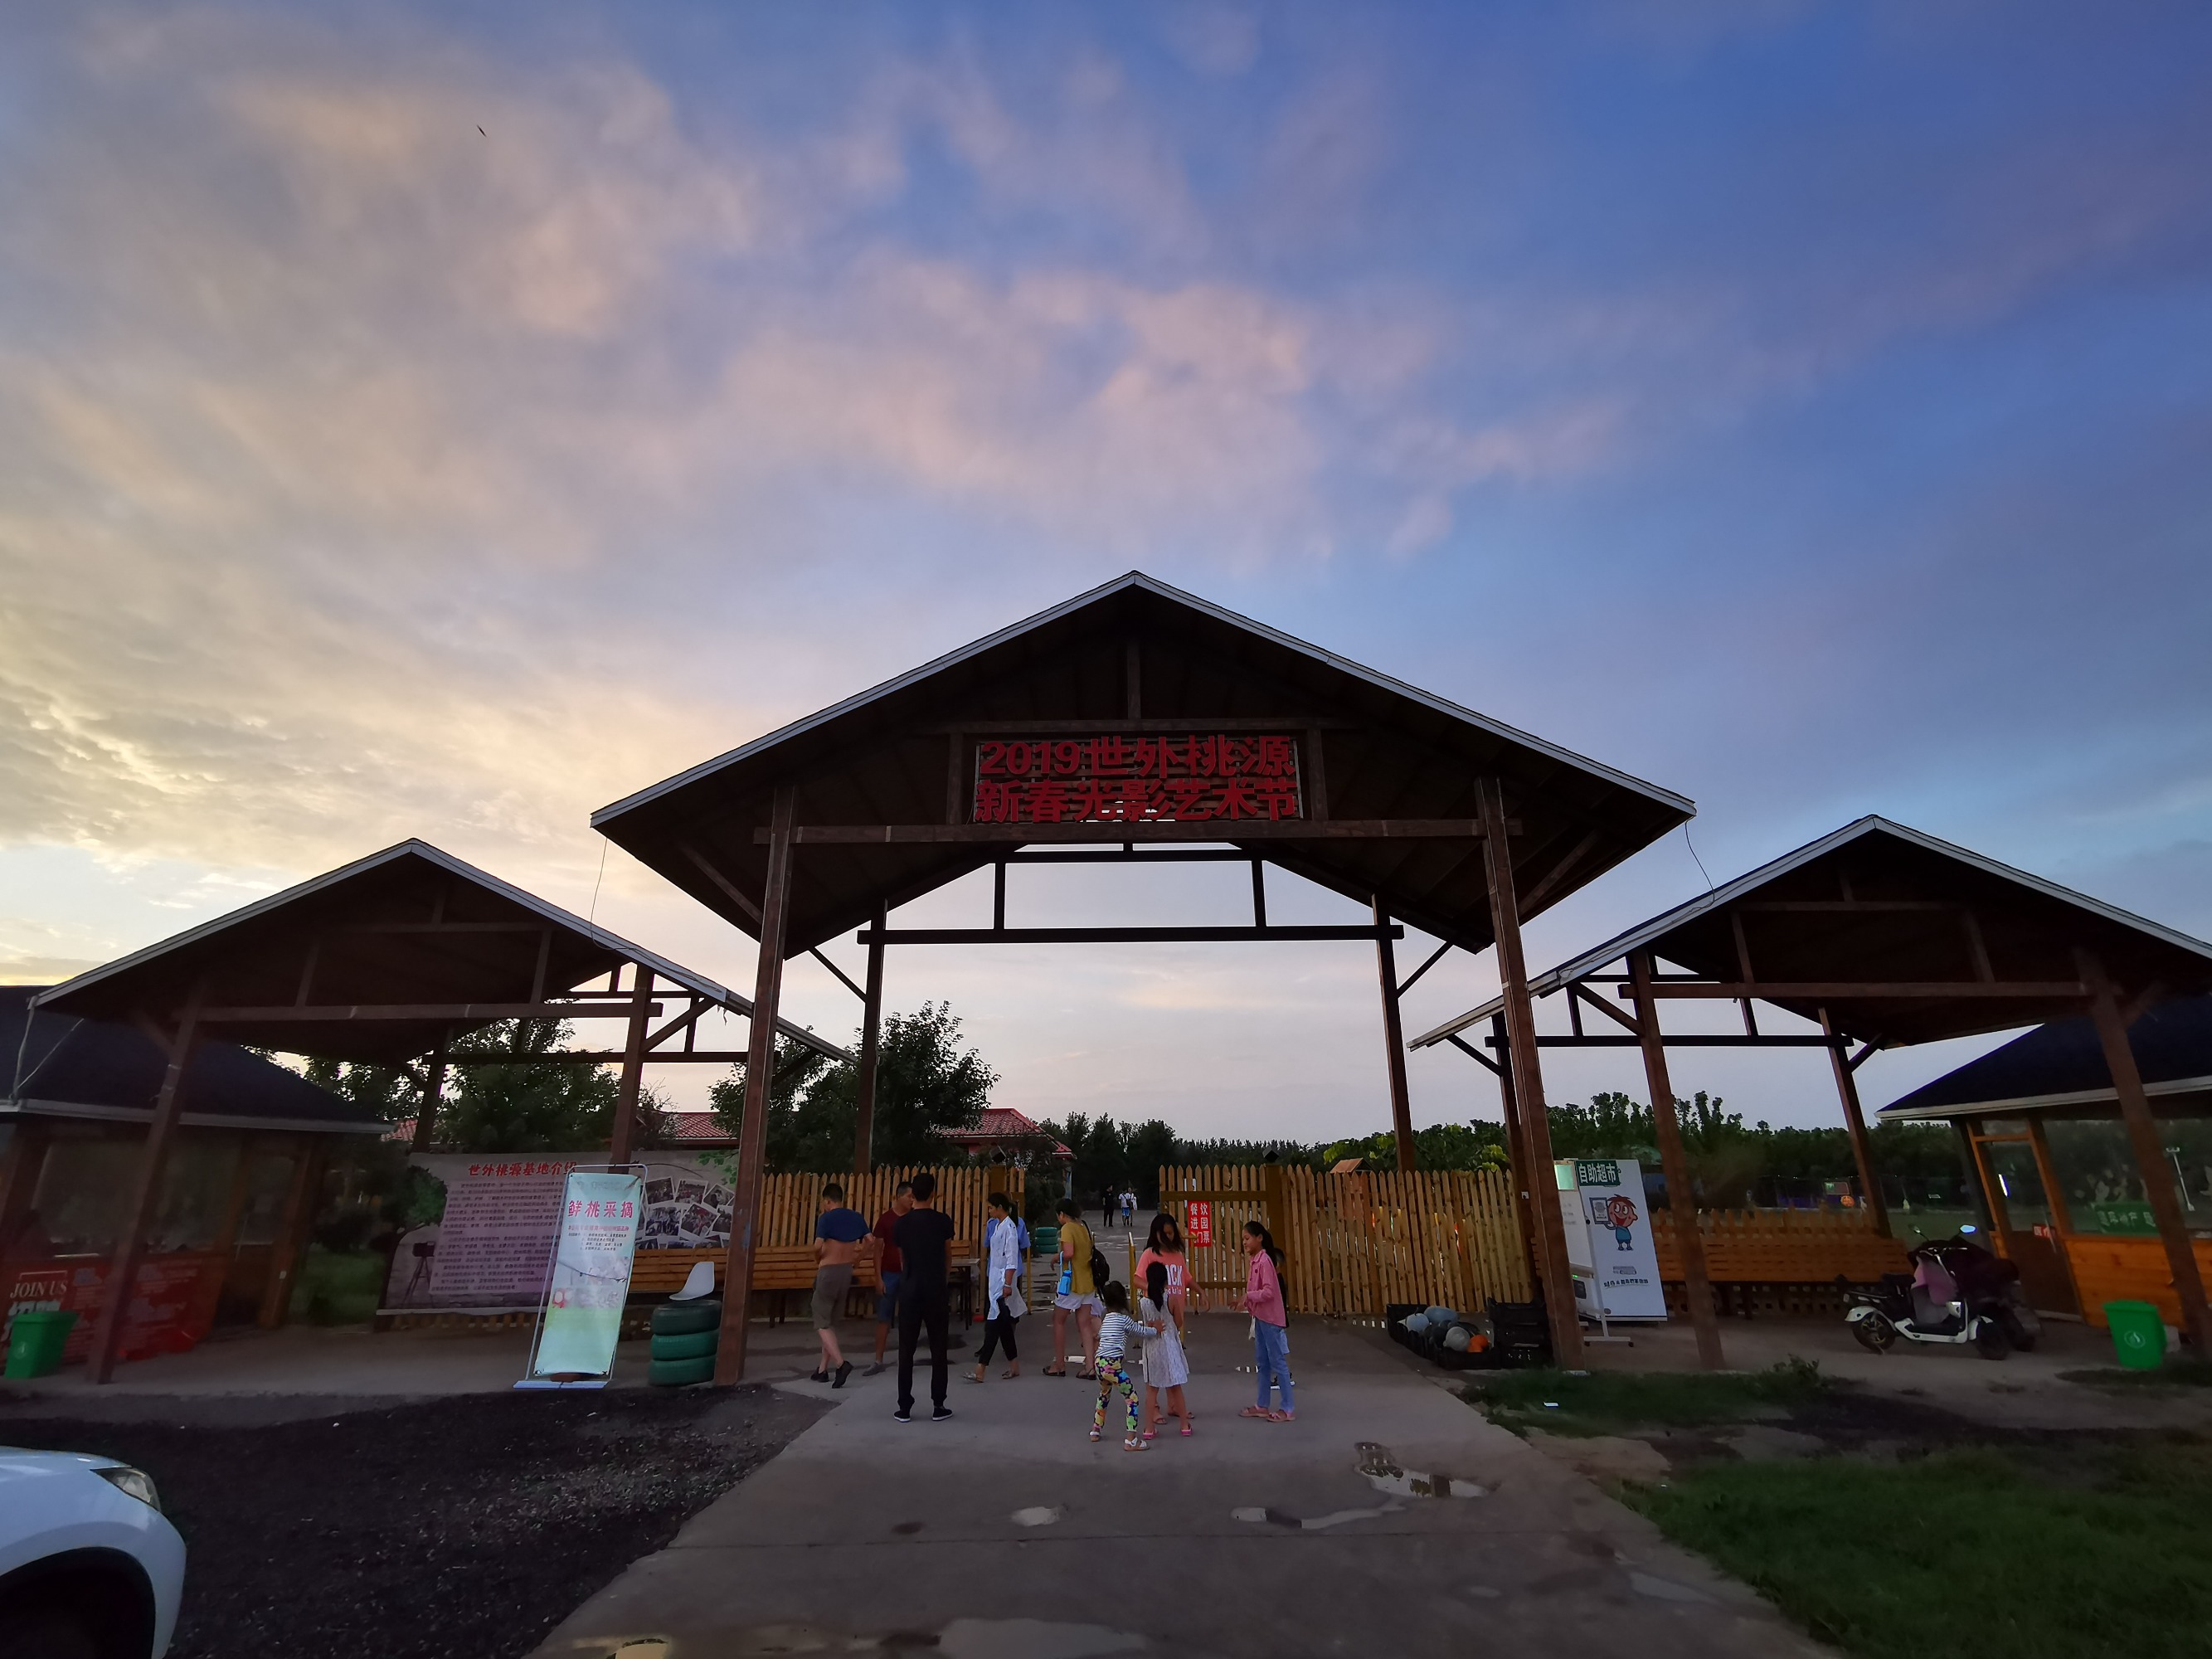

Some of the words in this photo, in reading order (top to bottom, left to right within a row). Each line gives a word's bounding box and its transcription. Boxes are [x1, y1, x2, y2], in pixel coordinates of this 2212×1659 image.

[980, 733, 1296, 778] 2019世外桃源
[975, 776, 1298, 822] 新春光影艺术节
[468, 1161, 577, 1176] 世外桃源基地介绍
[1578, 1163, 1617, 1184] 自助超市
[567, 1199, 634, 1218] 鲜桃采摘
[1190, 1203, 1208, 1215] 餐饮
[1190, 1217, 1208, 1229] 进园
[9, 1281, 47, 1299] JOIN
[49, 1280, 68, 1296] US
